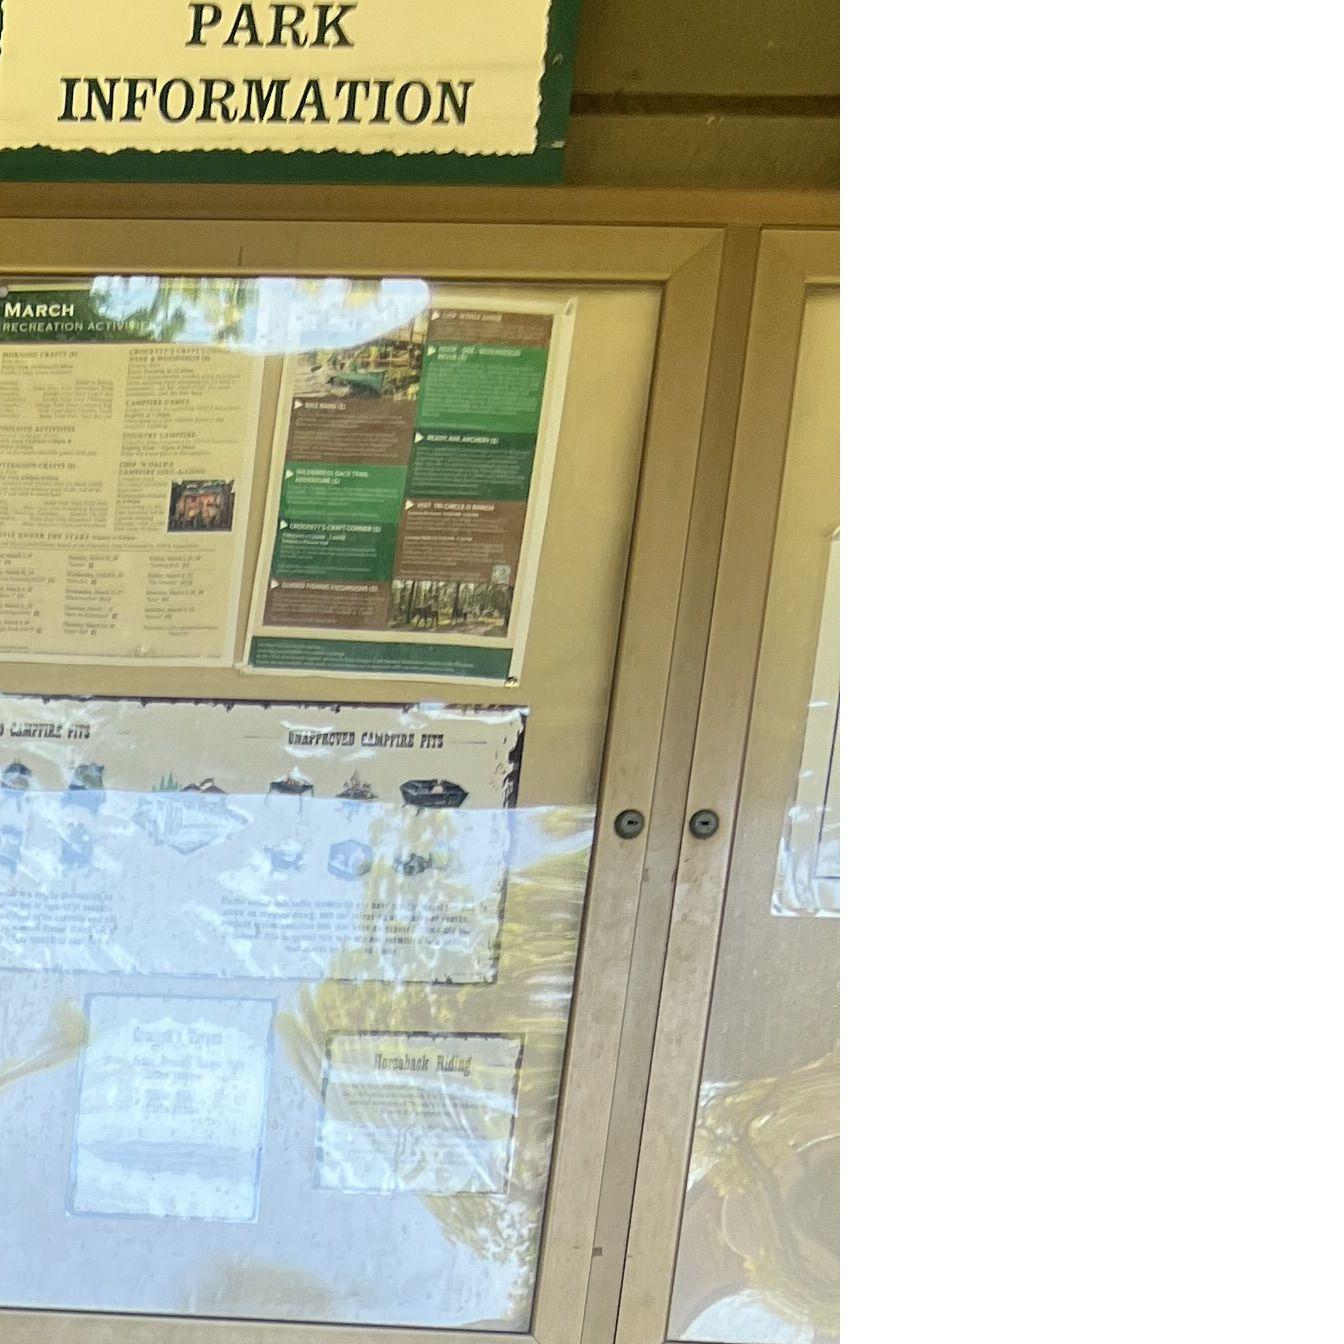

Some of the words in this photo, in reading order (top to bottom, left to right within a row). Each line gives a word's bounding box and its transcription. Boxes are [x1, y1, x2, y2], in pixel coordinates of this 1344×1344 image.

[184, 2, 356, 48] PARK
[57, 77, 475, 126] INFORMATION
[4, 302, 75, 318] MARCH
[2, 321, 83, 333] RECREATION
[288, 730, 355, 746] UNAPPROVED
[361, 732, 414, 748] CAMPFIRE
[420, 733, 445, 749] PITS
[374, 1053, 430, 1071] Horseback
[435, 1055, 473, 1077] Riding
